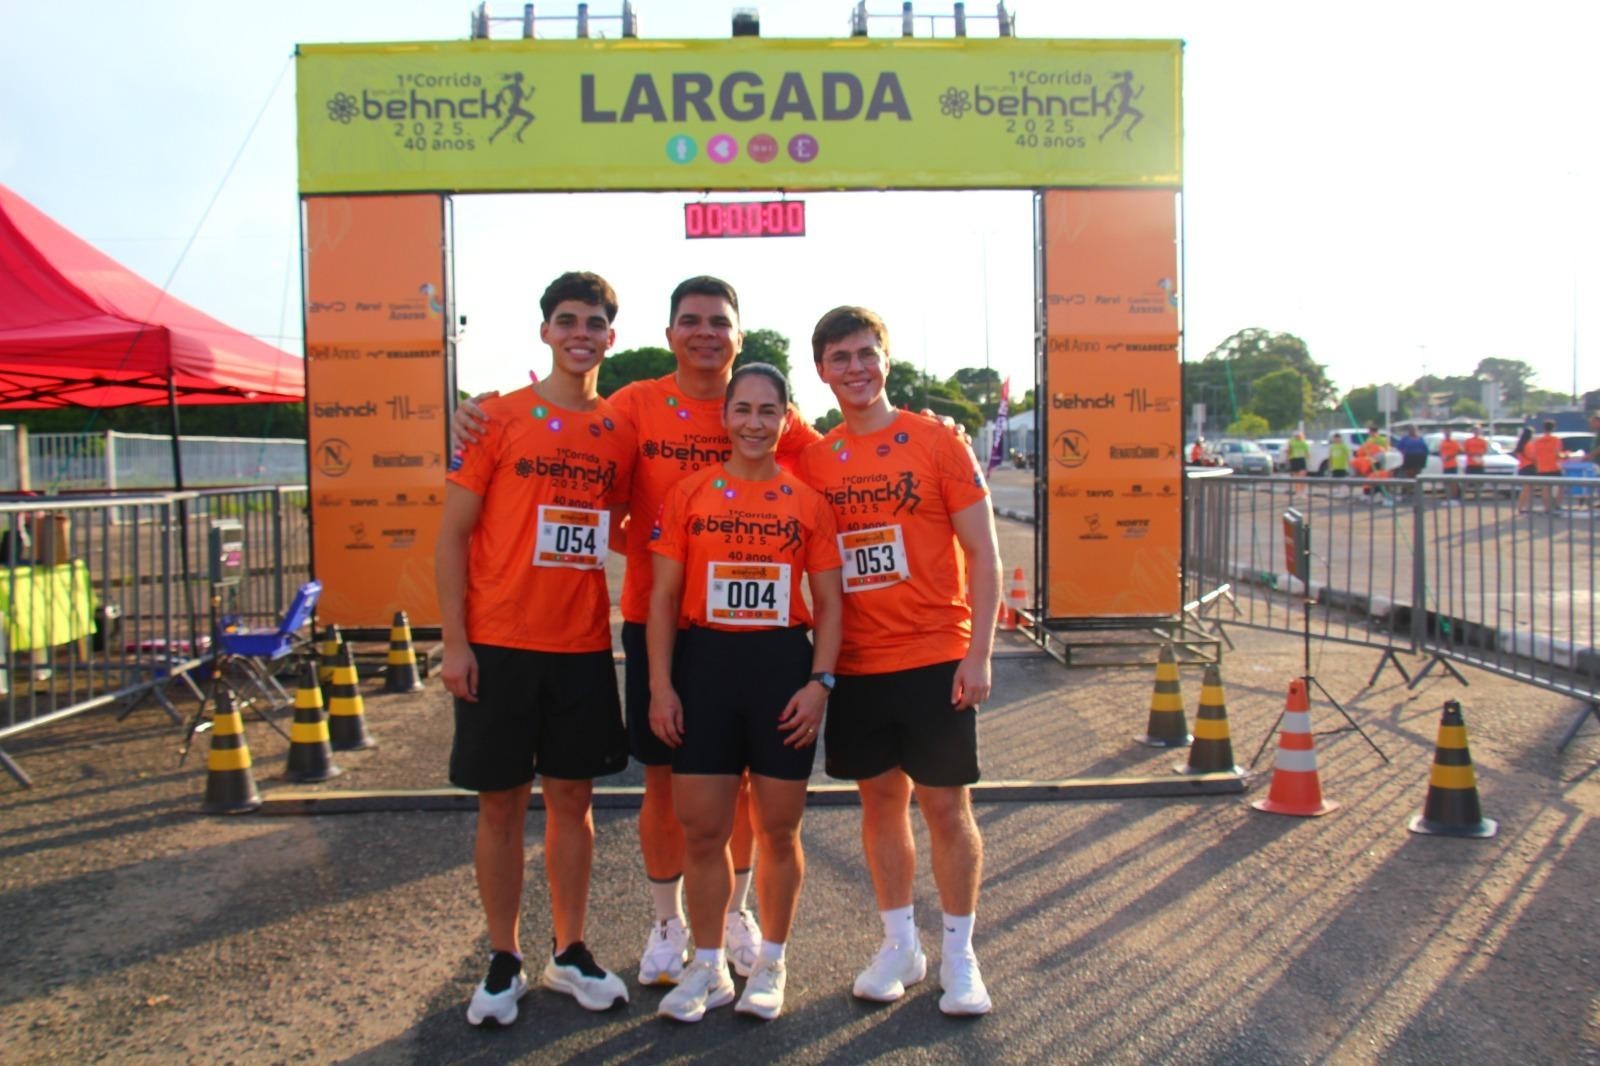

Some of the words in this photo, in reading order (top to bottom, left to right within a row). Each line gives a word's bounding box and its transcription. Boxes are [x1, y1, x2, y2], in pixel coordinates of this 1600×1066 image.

[362, 89, 502, 120] behnck
[580, 71, 913, 123] LARGADA
[974, 85, 1112, 117] behnck
[404, 137, 427, 151] 40
[431, 138, 476, 150] anos
[1015, 134, 1039, 148] 40
[1043, 135, 1086, 148] anos
[686, 201, 803, 236] 00:00:00
[314, 401, 377, 418] behnck
[1053, 392, 1116, 409] behnck
[535, 456, 608, 485] behnck
[552, 495, 566, 505] 40
[555, 525, 597, 555] 054
[706, 515, 790, 538] behnck
[728, 551, 743, 561] 40
[745, 552, 773, 562] anos
[855, 544, 896, 576] 053
[727, 581, 777, 609] 004
